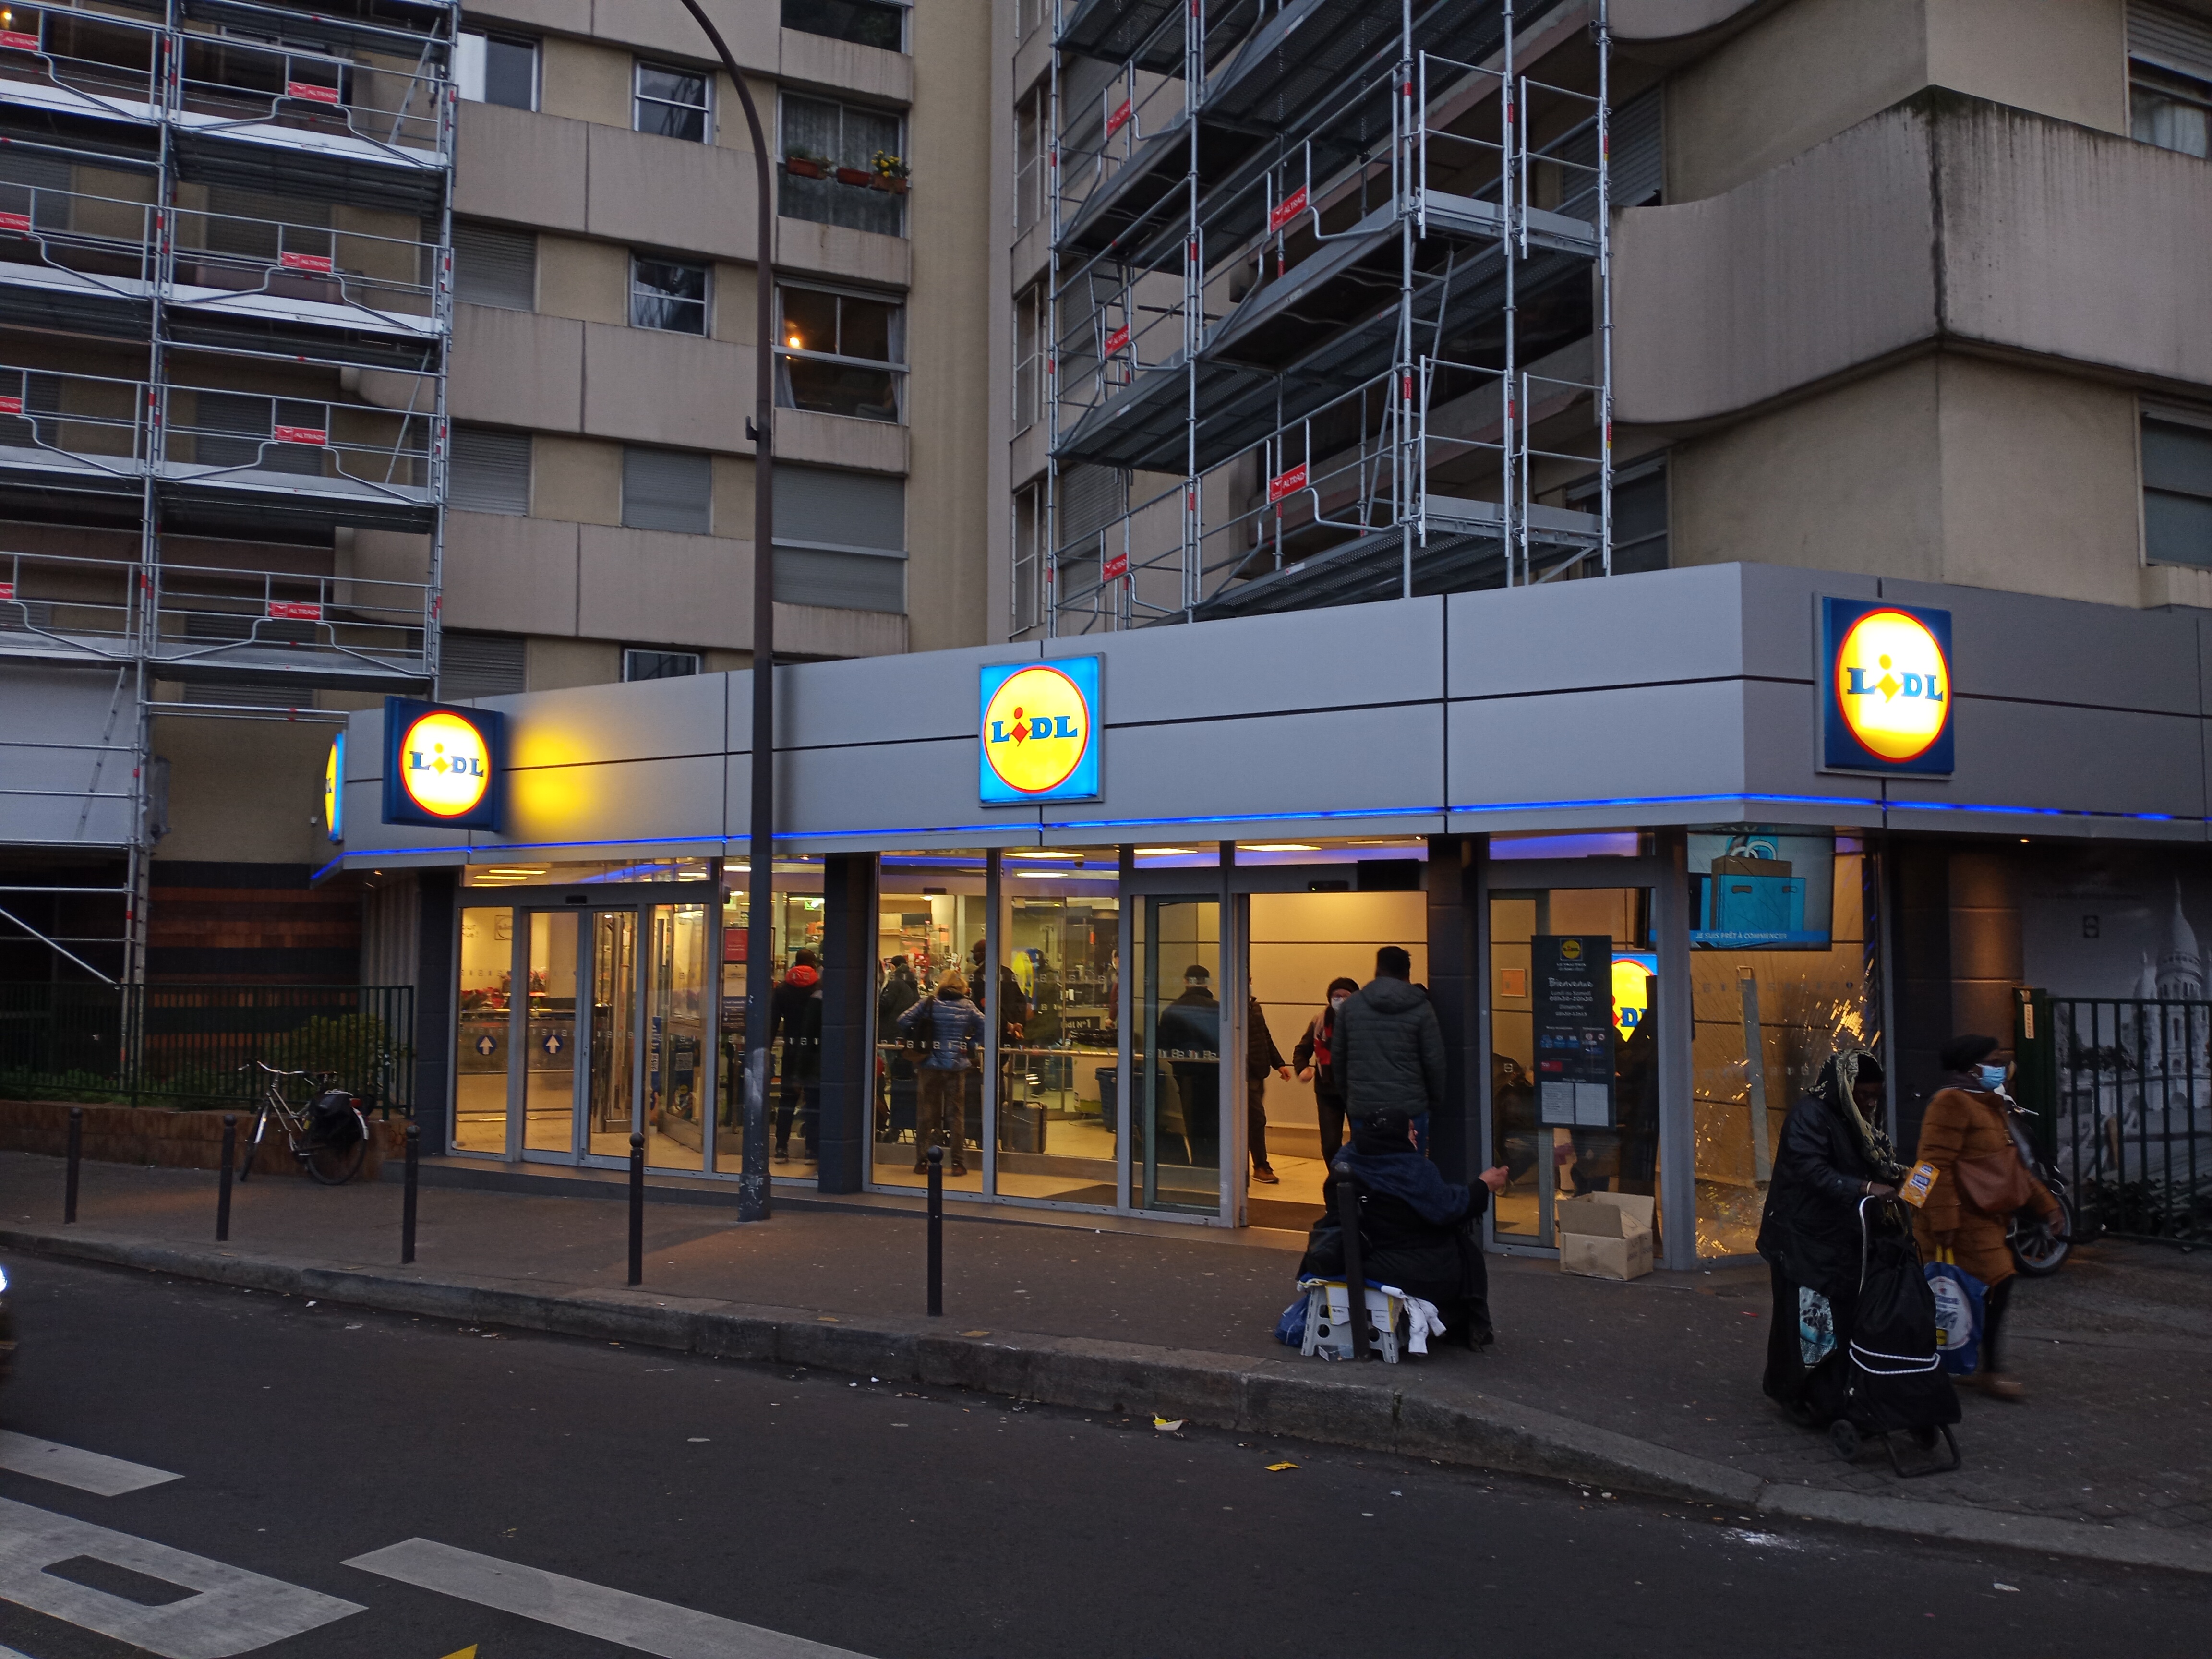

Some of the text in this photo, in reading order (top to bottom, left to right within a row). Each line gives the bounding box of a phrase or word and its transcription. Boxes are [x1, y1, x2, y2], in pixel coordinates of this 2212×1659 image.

[1283, 193, 1306, 216] ALTRAD
[0, 216, 28, 227] LTRAD
[294, 432, 323, 441] ALTRAD
[1282, 471, 1305, 489] ALTRAD
[1548, 976, 1594, 987] Bienvenue
